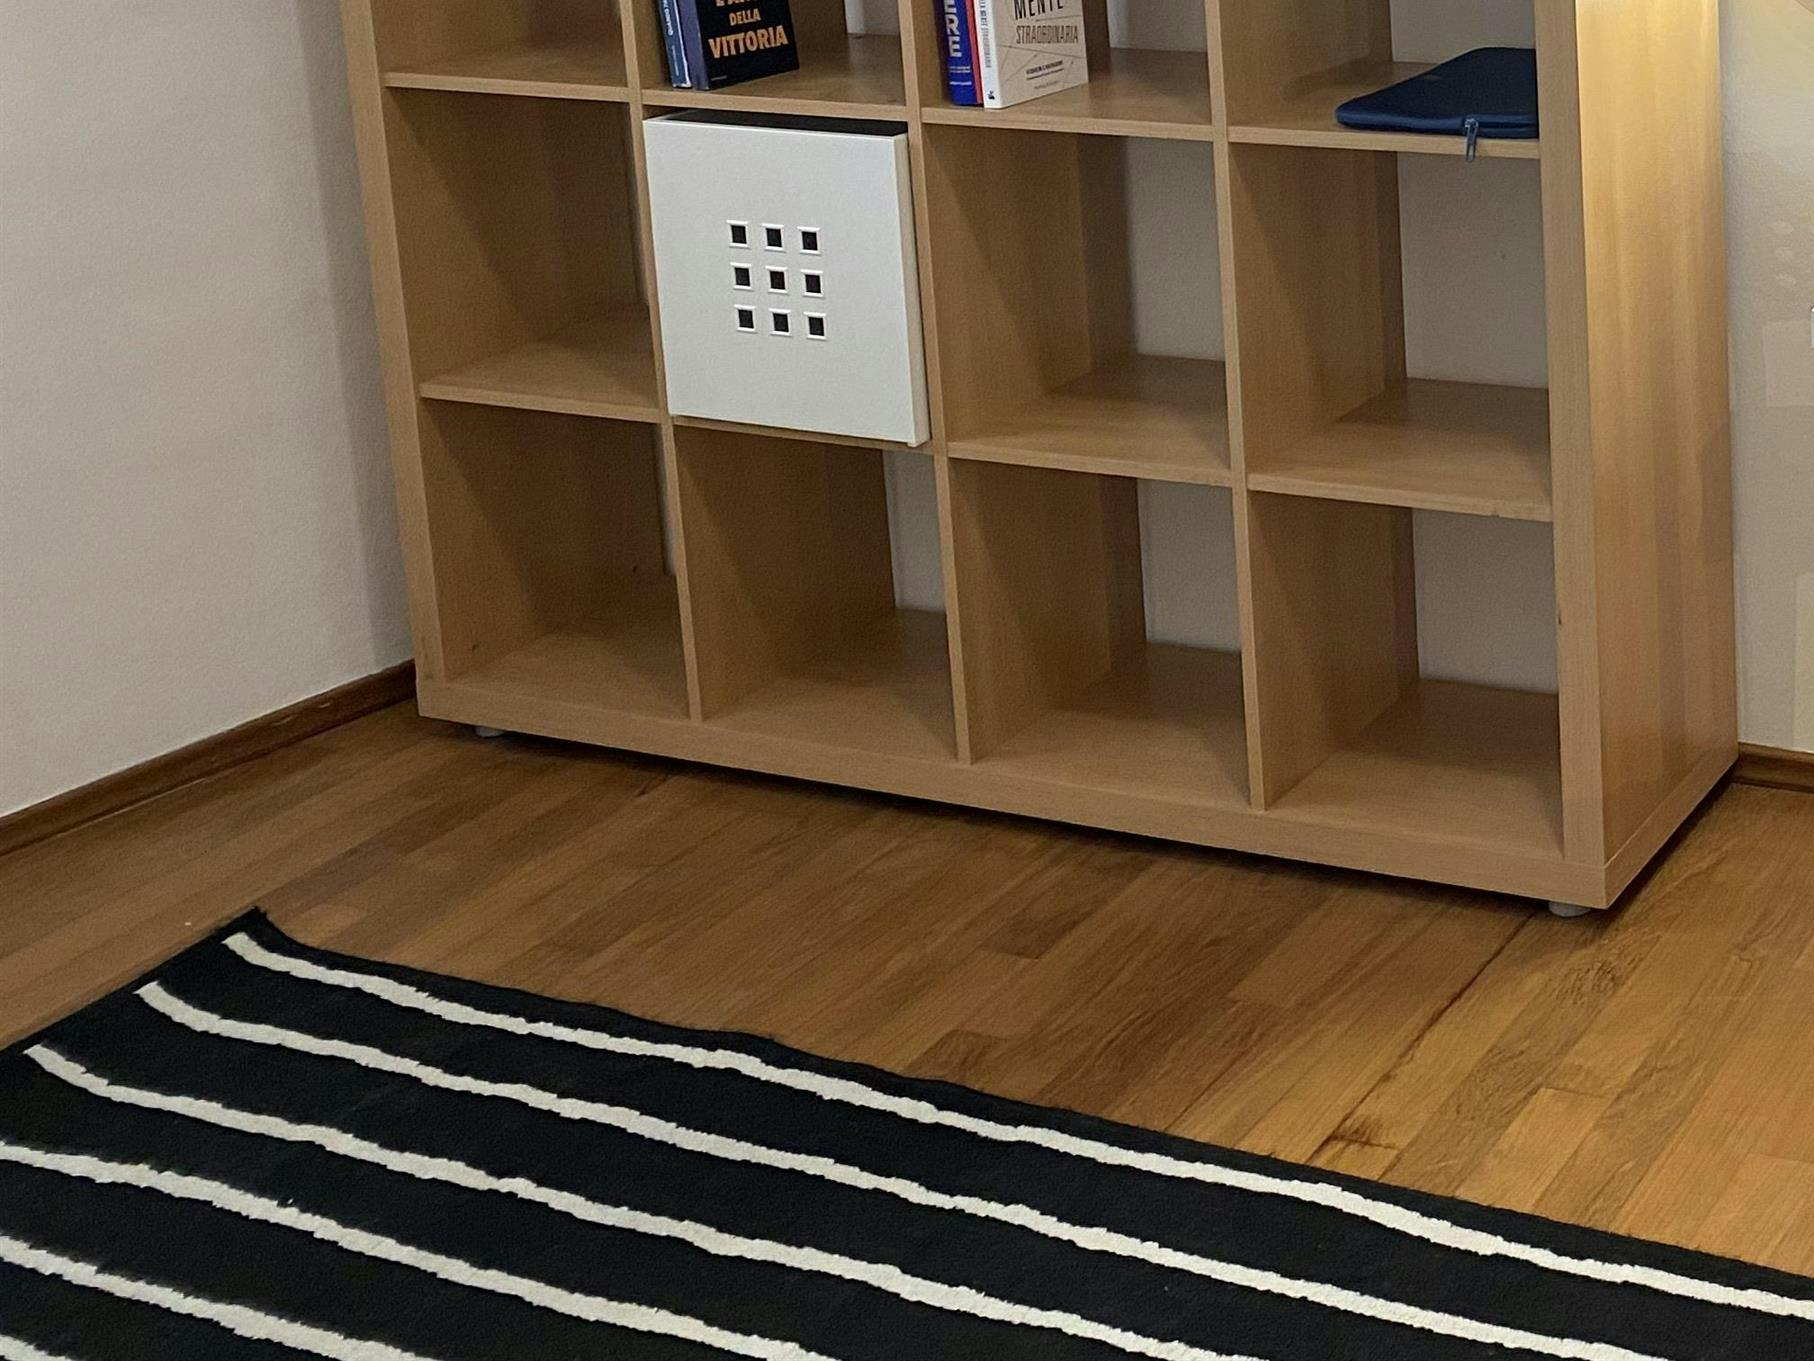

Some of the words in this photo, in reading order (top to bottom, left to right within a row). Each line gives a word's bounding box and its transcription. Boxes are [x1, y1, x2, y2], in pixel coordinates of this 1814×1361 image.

[728, 8, 762, 27] DELLA
[708, 24, 789, 60] VITTORIA
[1015, 24, 1079, 45] STRAORDINARIA
